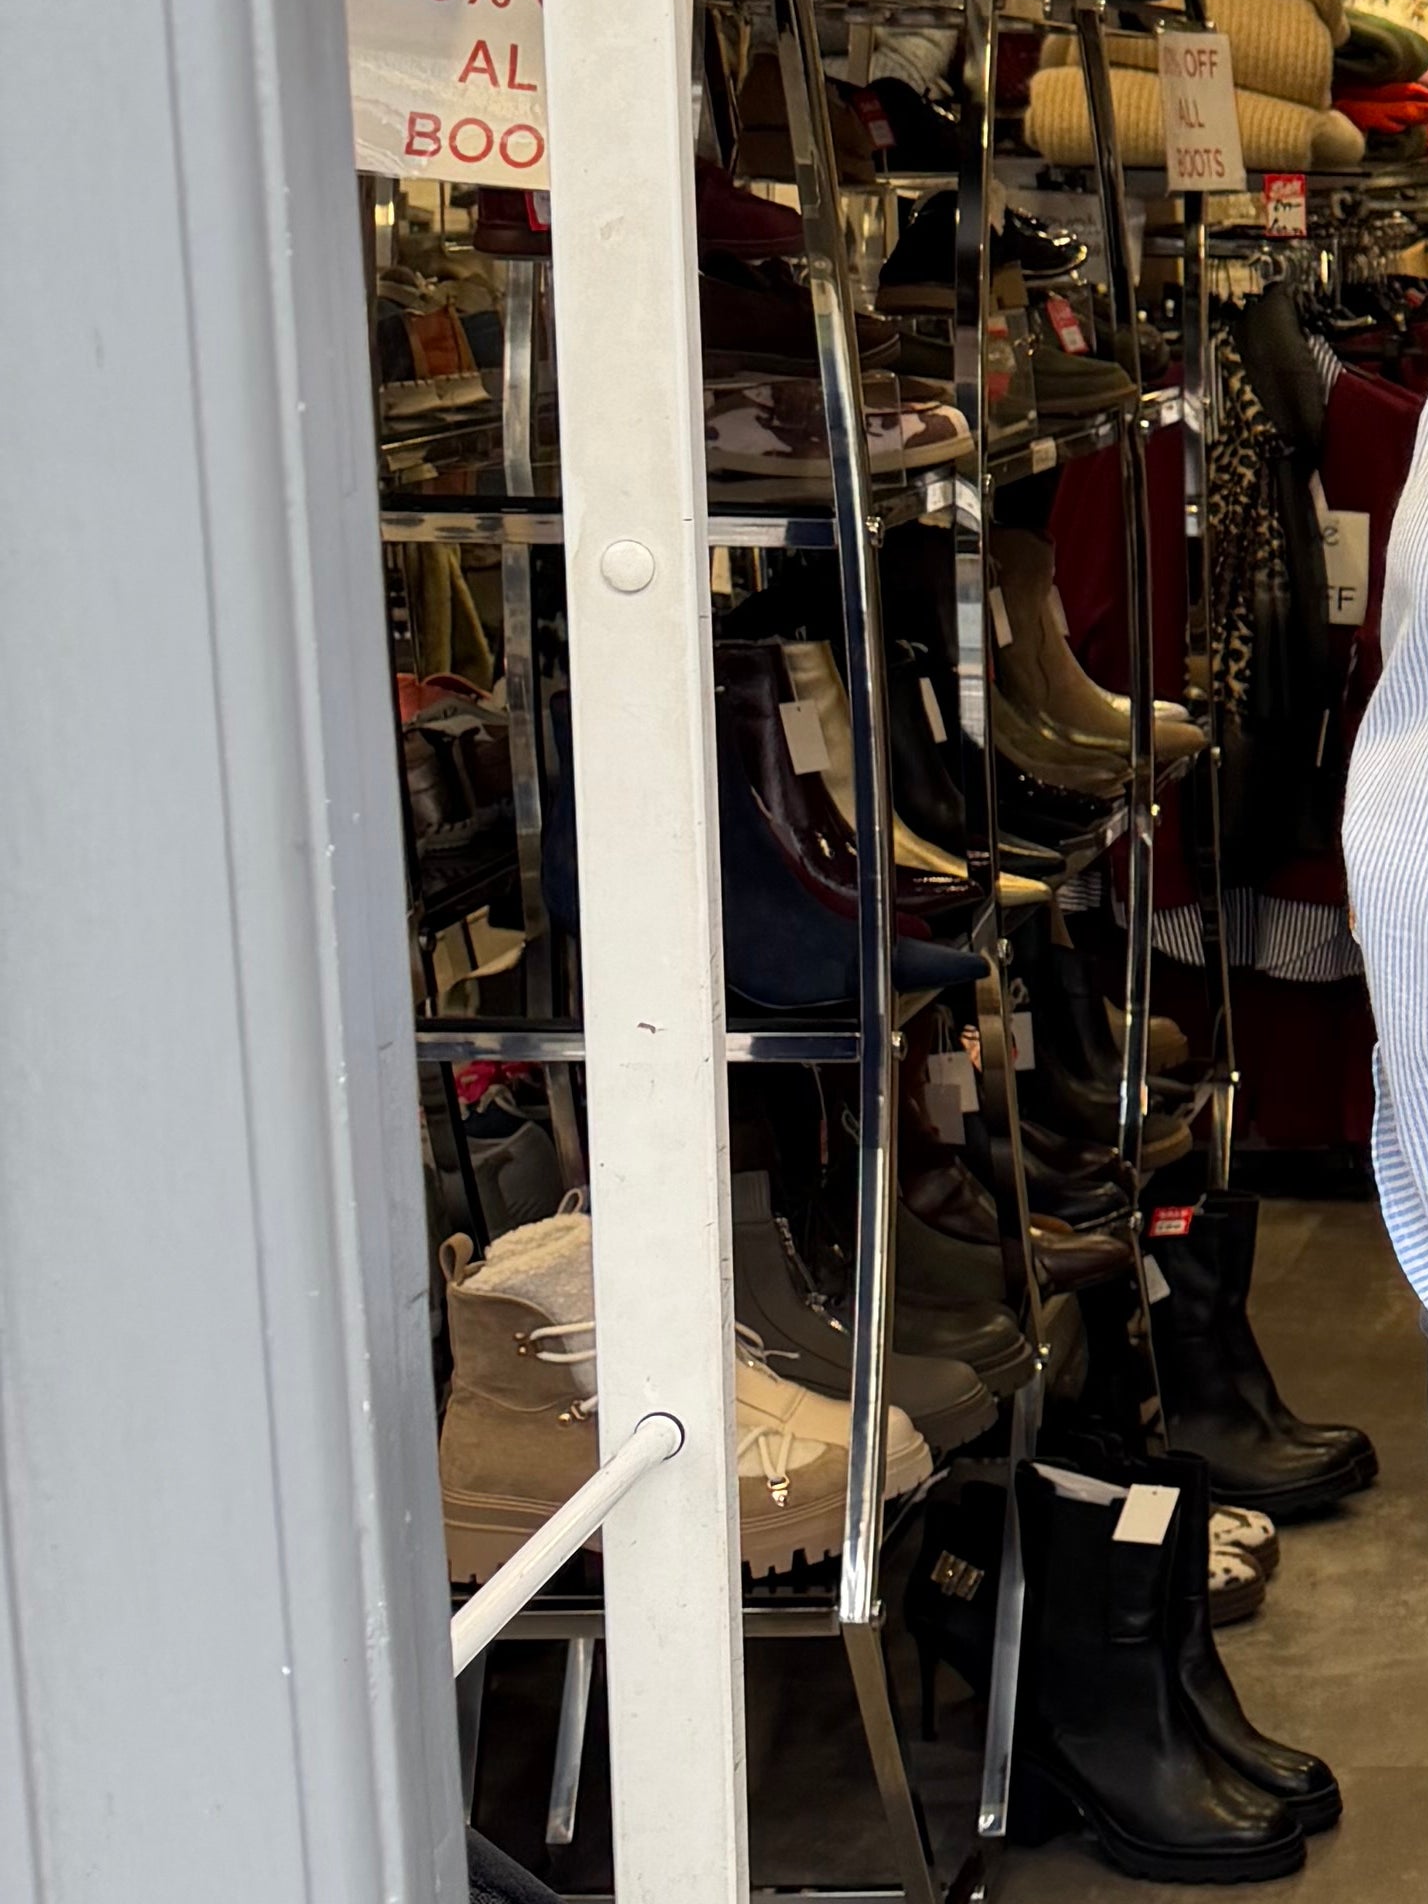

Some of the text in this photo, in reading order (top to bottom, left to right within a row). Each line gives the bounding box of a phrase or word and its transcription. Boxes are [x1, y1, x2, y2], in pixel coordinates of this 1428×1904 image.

[457, 39, 539, 92] AL
[1183, 48, 1218, 79] OFF
[403, 111, 546, 169] BOO
